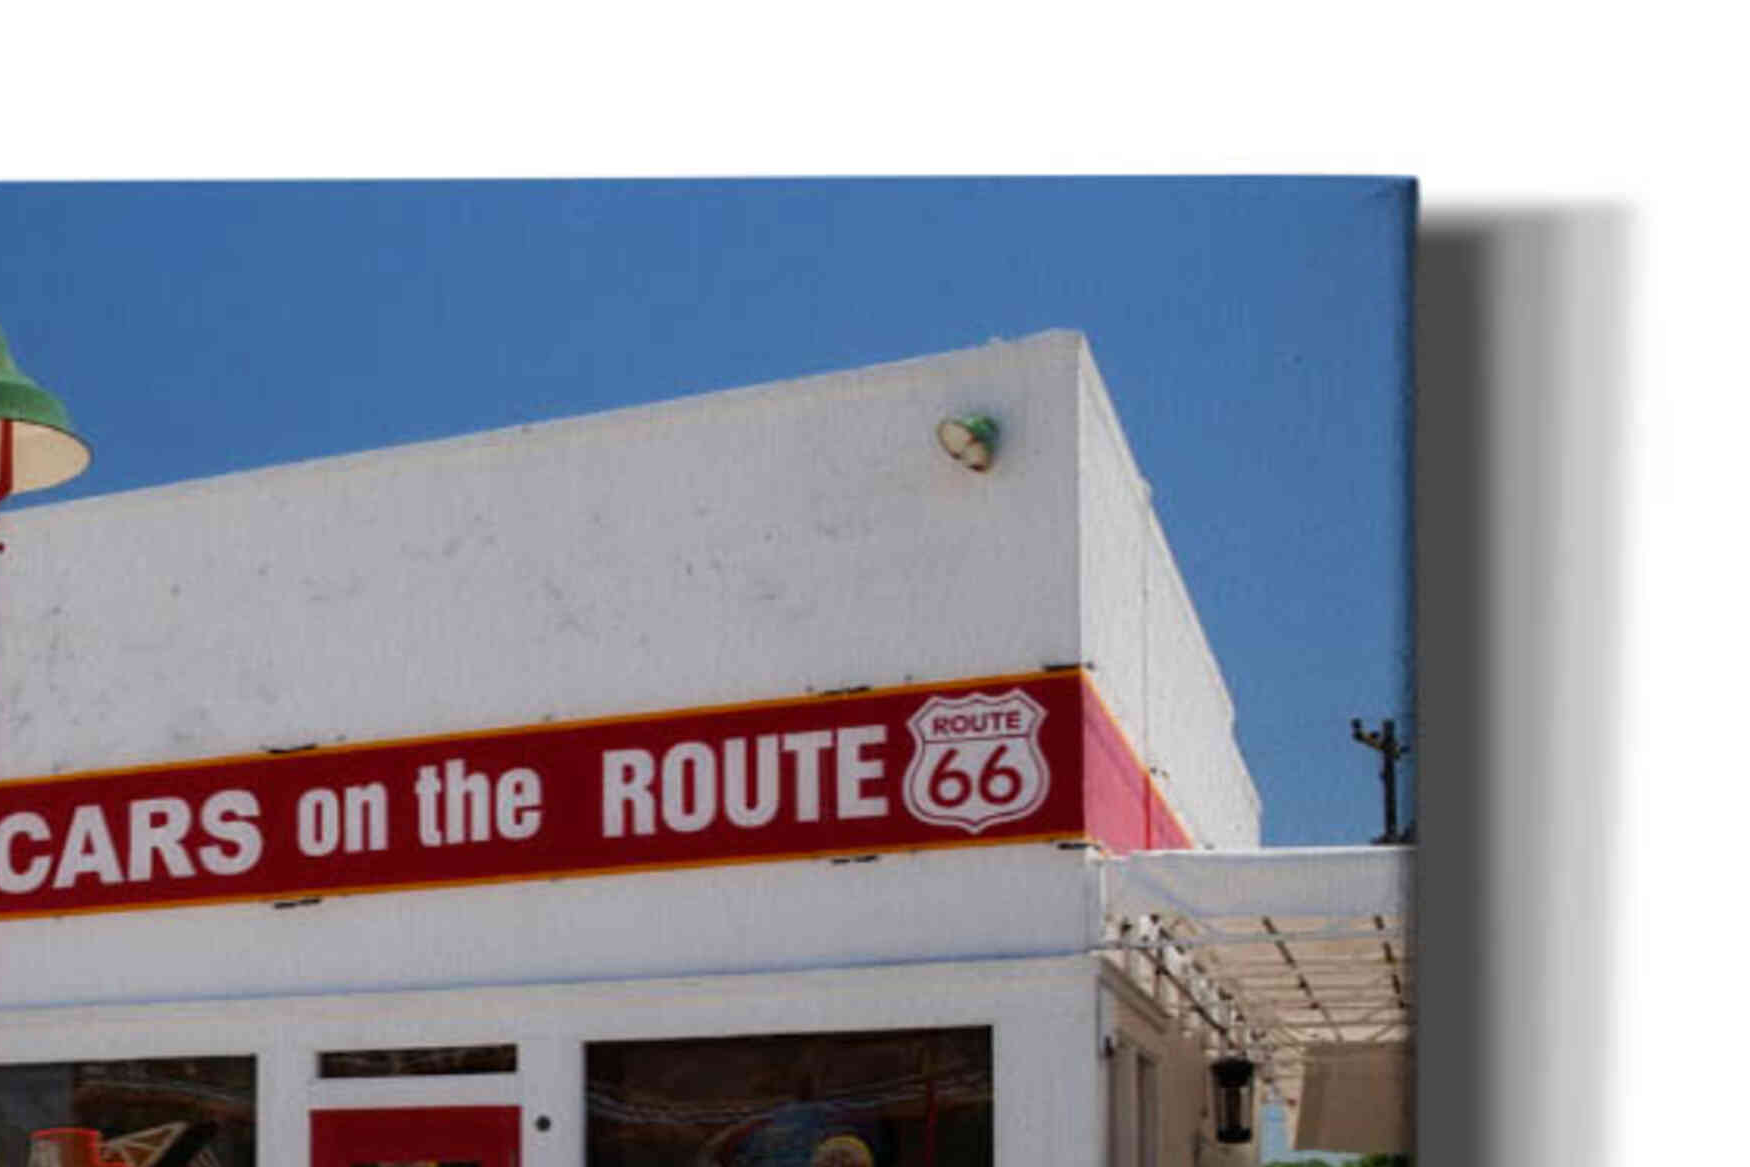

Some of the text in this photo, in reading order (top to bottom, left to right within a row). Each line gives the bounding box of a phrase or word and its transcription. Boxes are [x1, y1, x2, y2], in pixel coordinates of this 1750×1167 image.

[931, 709, 1023, 736] ROUTE
[296, 782, 388, 859] on
[414, 758, 543, 850] the
[601, 723, 890, 838] ROUTE
[927, 744, 1023, 807] 66
